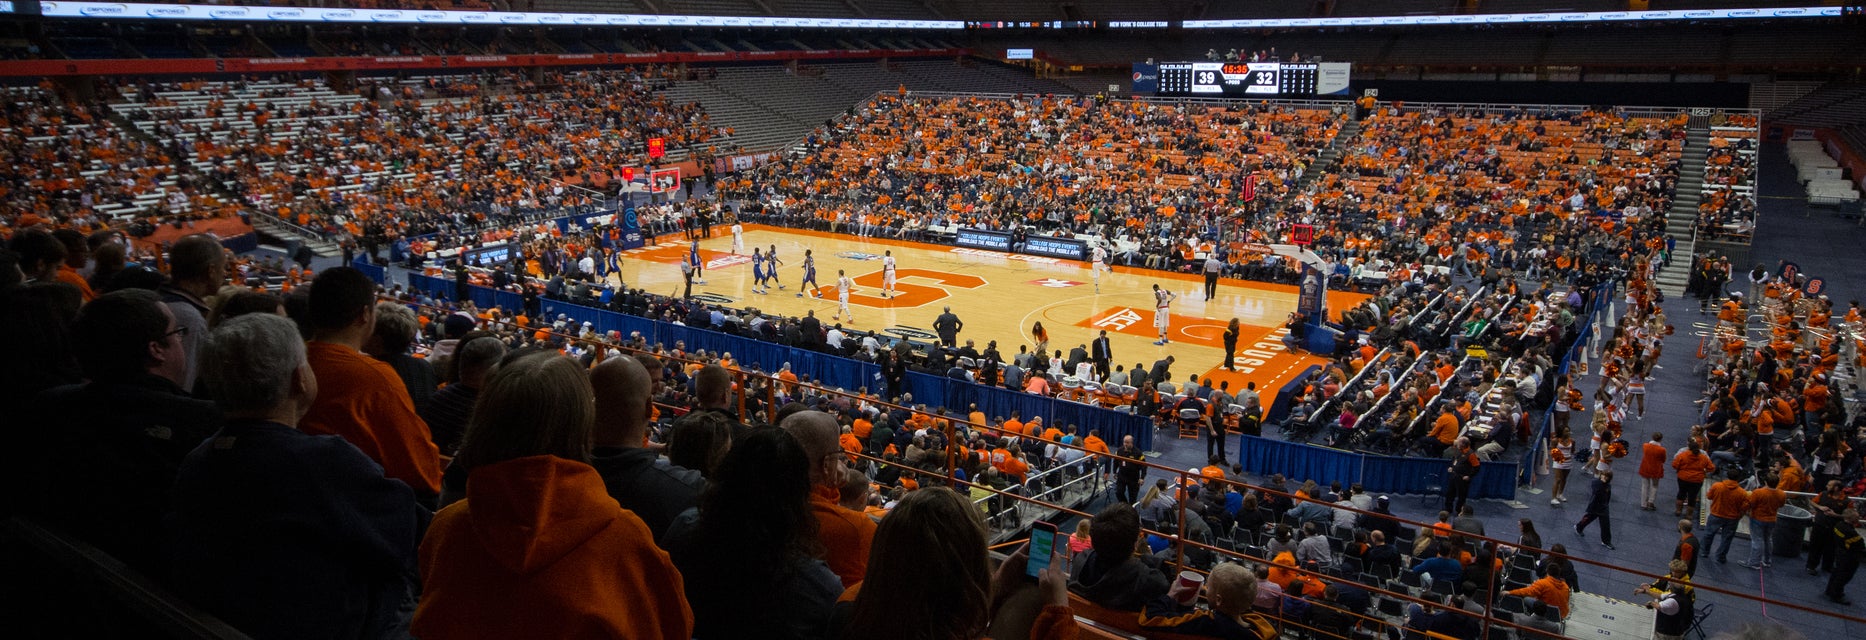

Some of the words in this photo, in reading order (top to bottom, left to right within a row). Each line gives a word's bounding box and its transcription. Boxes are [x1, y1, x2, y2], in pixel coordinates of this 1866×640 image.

[1223, 65, 1248, 74] 15:35
[1199, 71, 1215, 84] 39
[1256, 72, 1273, 85] 32
[1693, 108, 1709, 116] 125
[1027, 244, 1048, 252] DOWNLOAD
[1807, 279, 1823, 294] S
